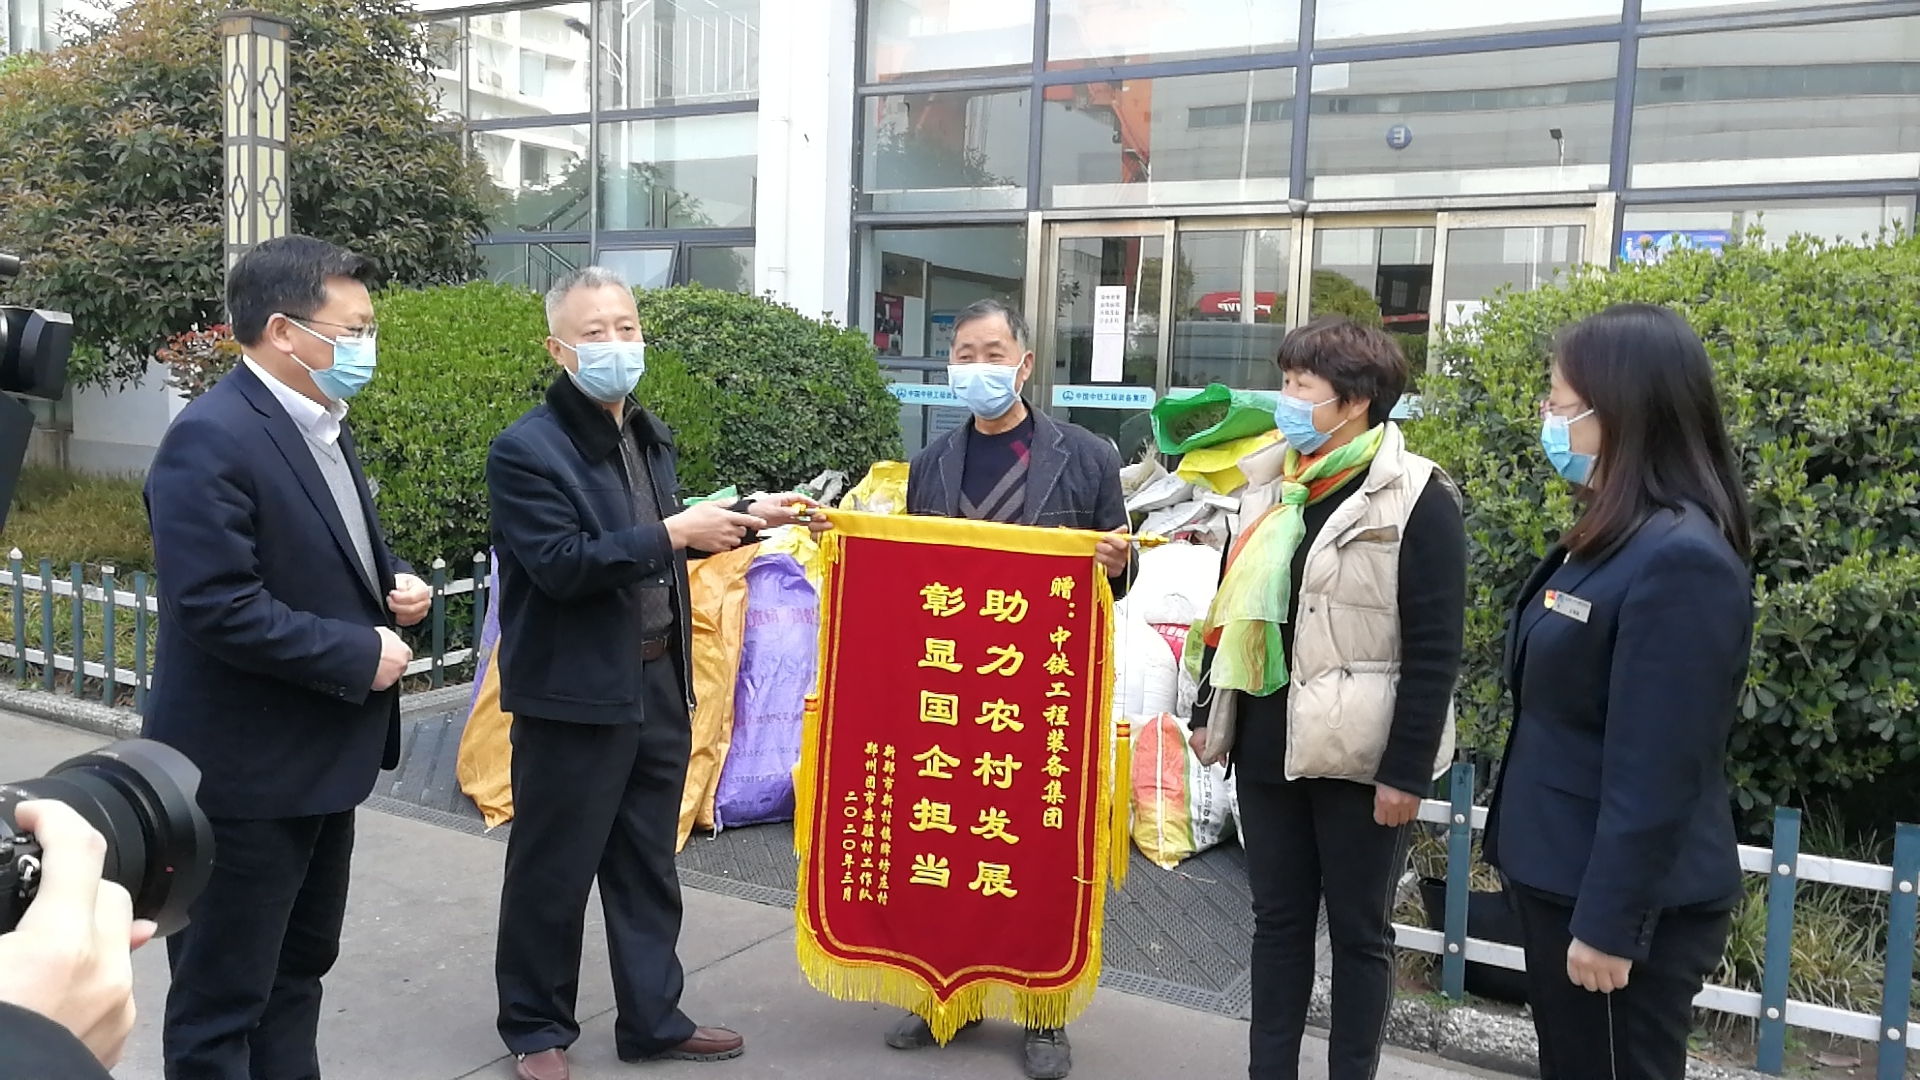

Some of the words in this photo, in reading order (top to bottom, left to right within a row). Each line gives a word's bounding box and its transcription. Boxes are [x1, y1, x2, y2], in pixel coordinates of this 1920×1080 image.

[909, 581, 967, 889] 彰显国企担当
[968, 588, 1029, 899] 助力农村发展
